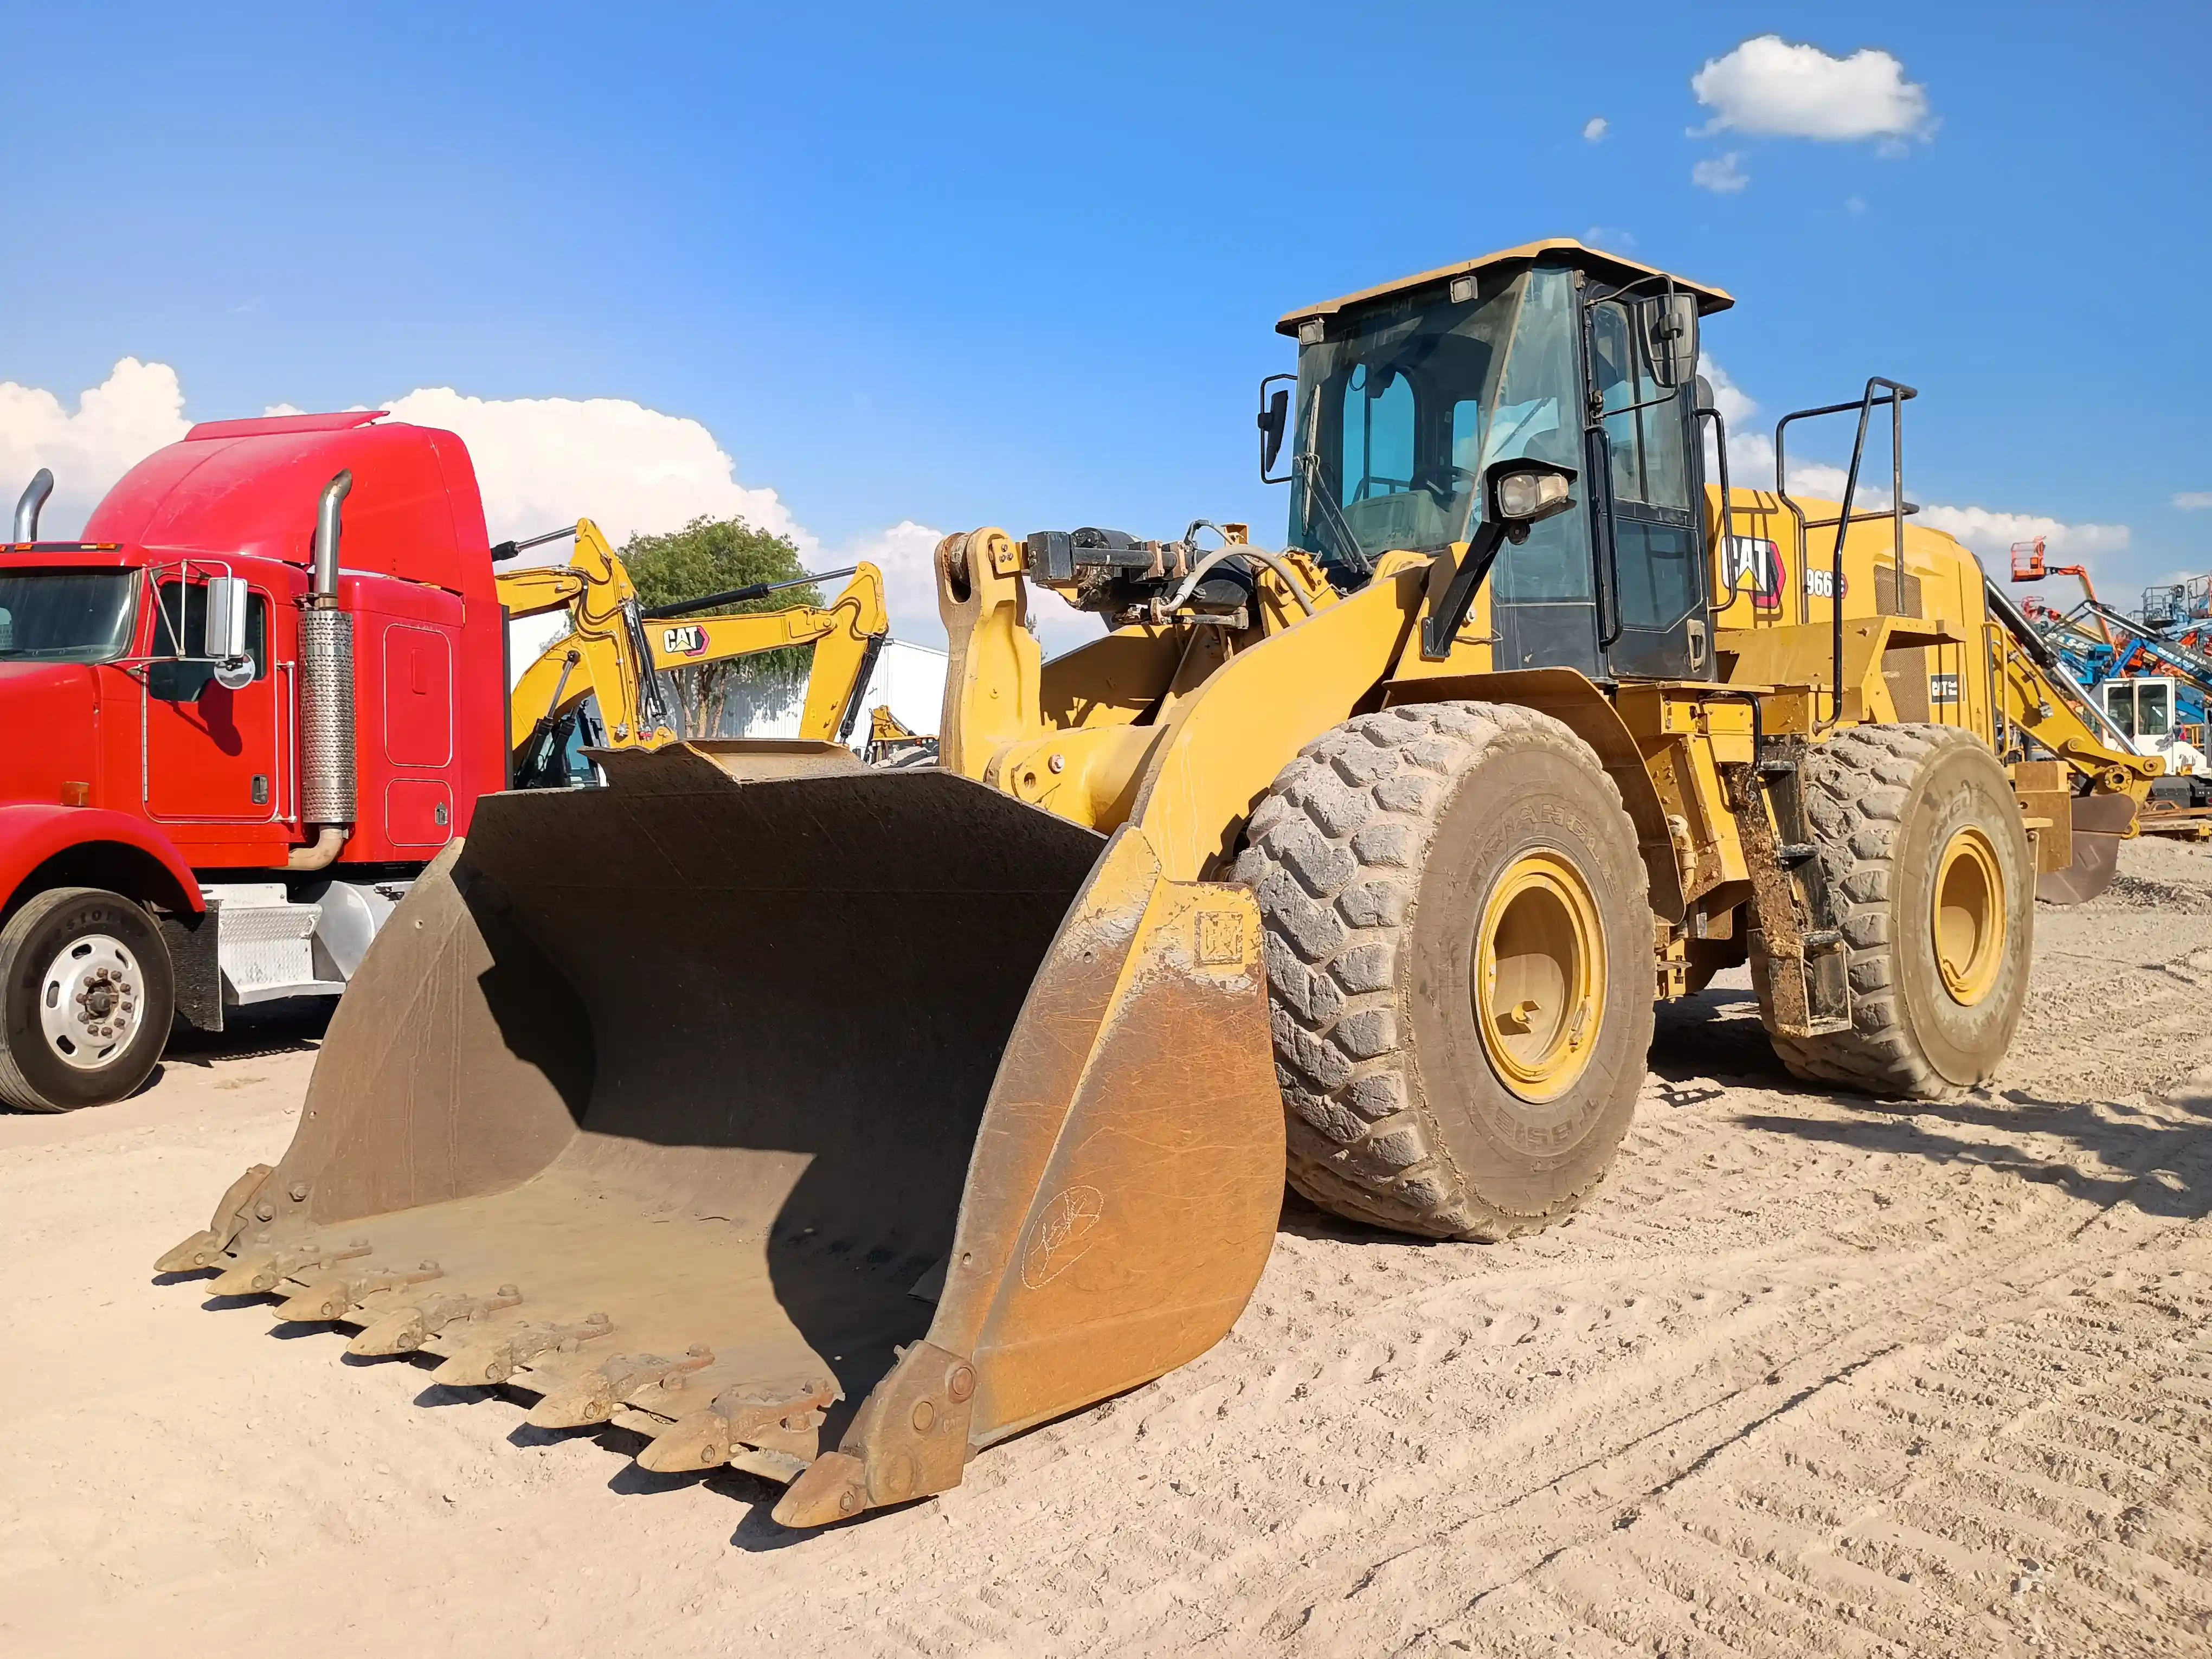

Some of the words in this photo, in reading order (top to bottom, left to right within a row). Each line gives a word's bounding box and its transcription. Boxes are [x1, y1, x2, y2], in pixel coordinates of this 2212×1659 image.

[1721, 535, 1771, 592] CAT
[1807, 568, 1832, 597] 966
[664, 626, 697, 653] CAT
